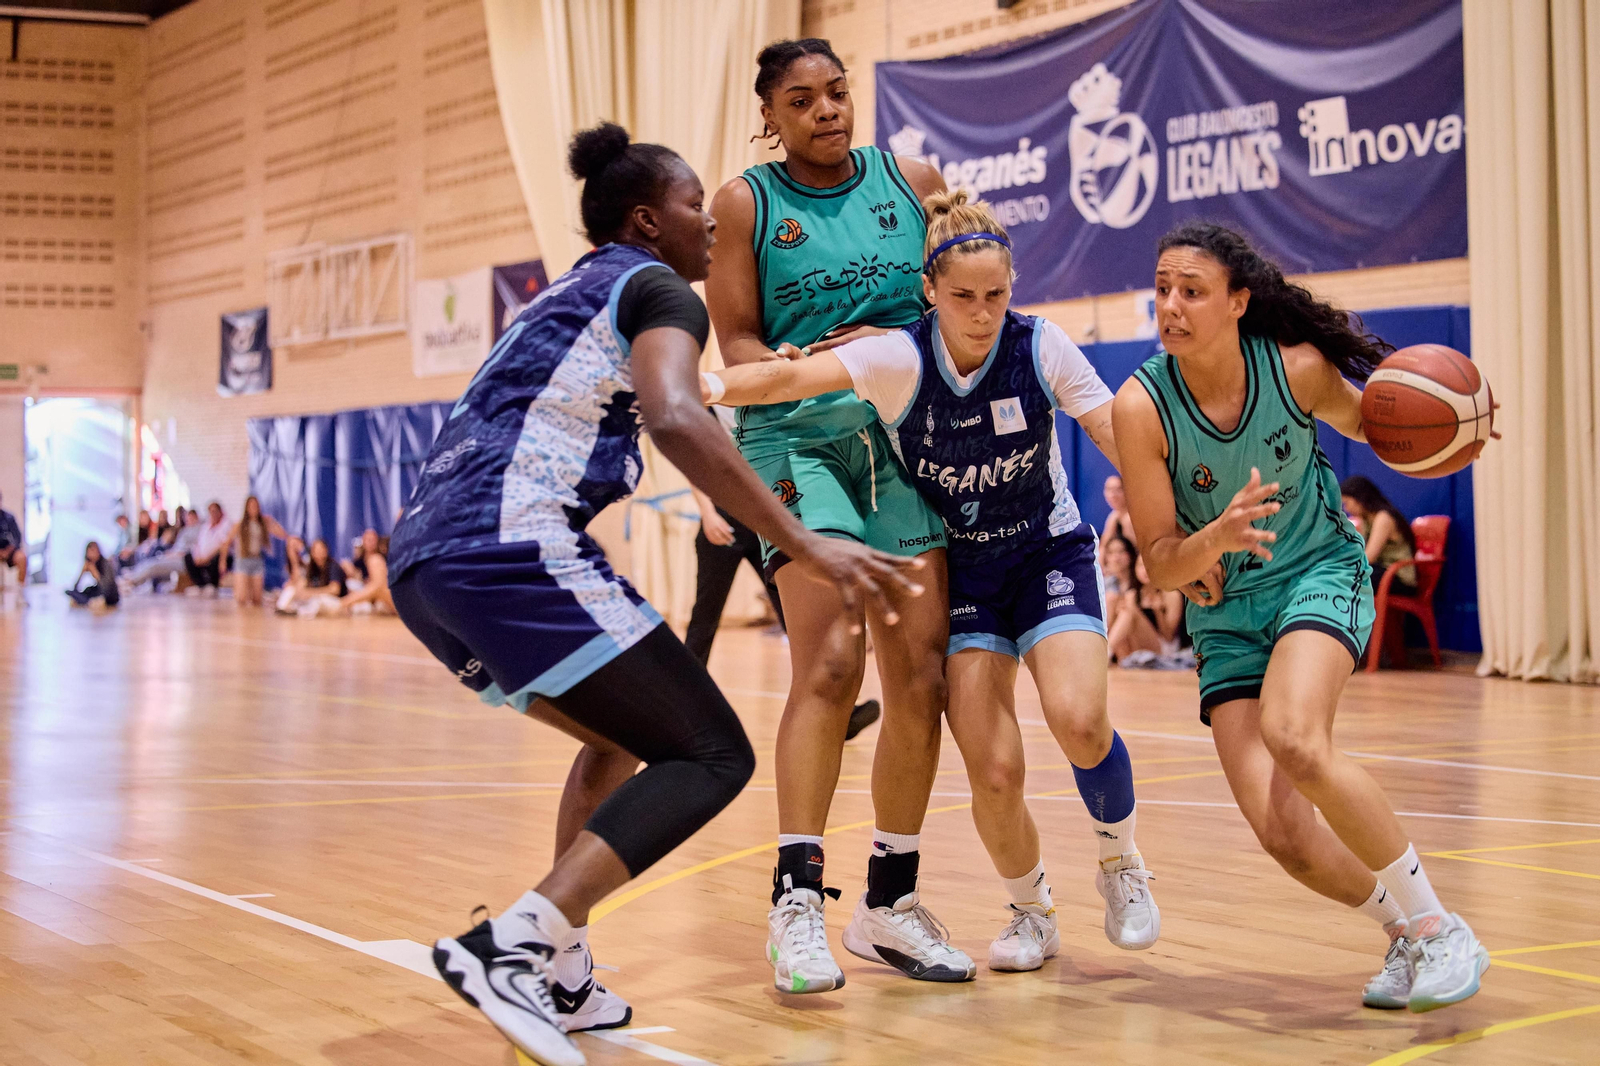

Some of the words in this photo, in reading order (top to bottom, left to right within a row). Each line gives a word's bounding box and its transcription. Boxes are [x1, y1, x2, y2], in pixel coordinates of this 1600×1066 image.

[869, 200, 896, 214] vive
[960, 415, 982, 428] WIBO
[1264, 424, 1288, 446] vive
[917, 443, 1039, 496] LEGANÉS
[960, 501, 980, 526] 9
